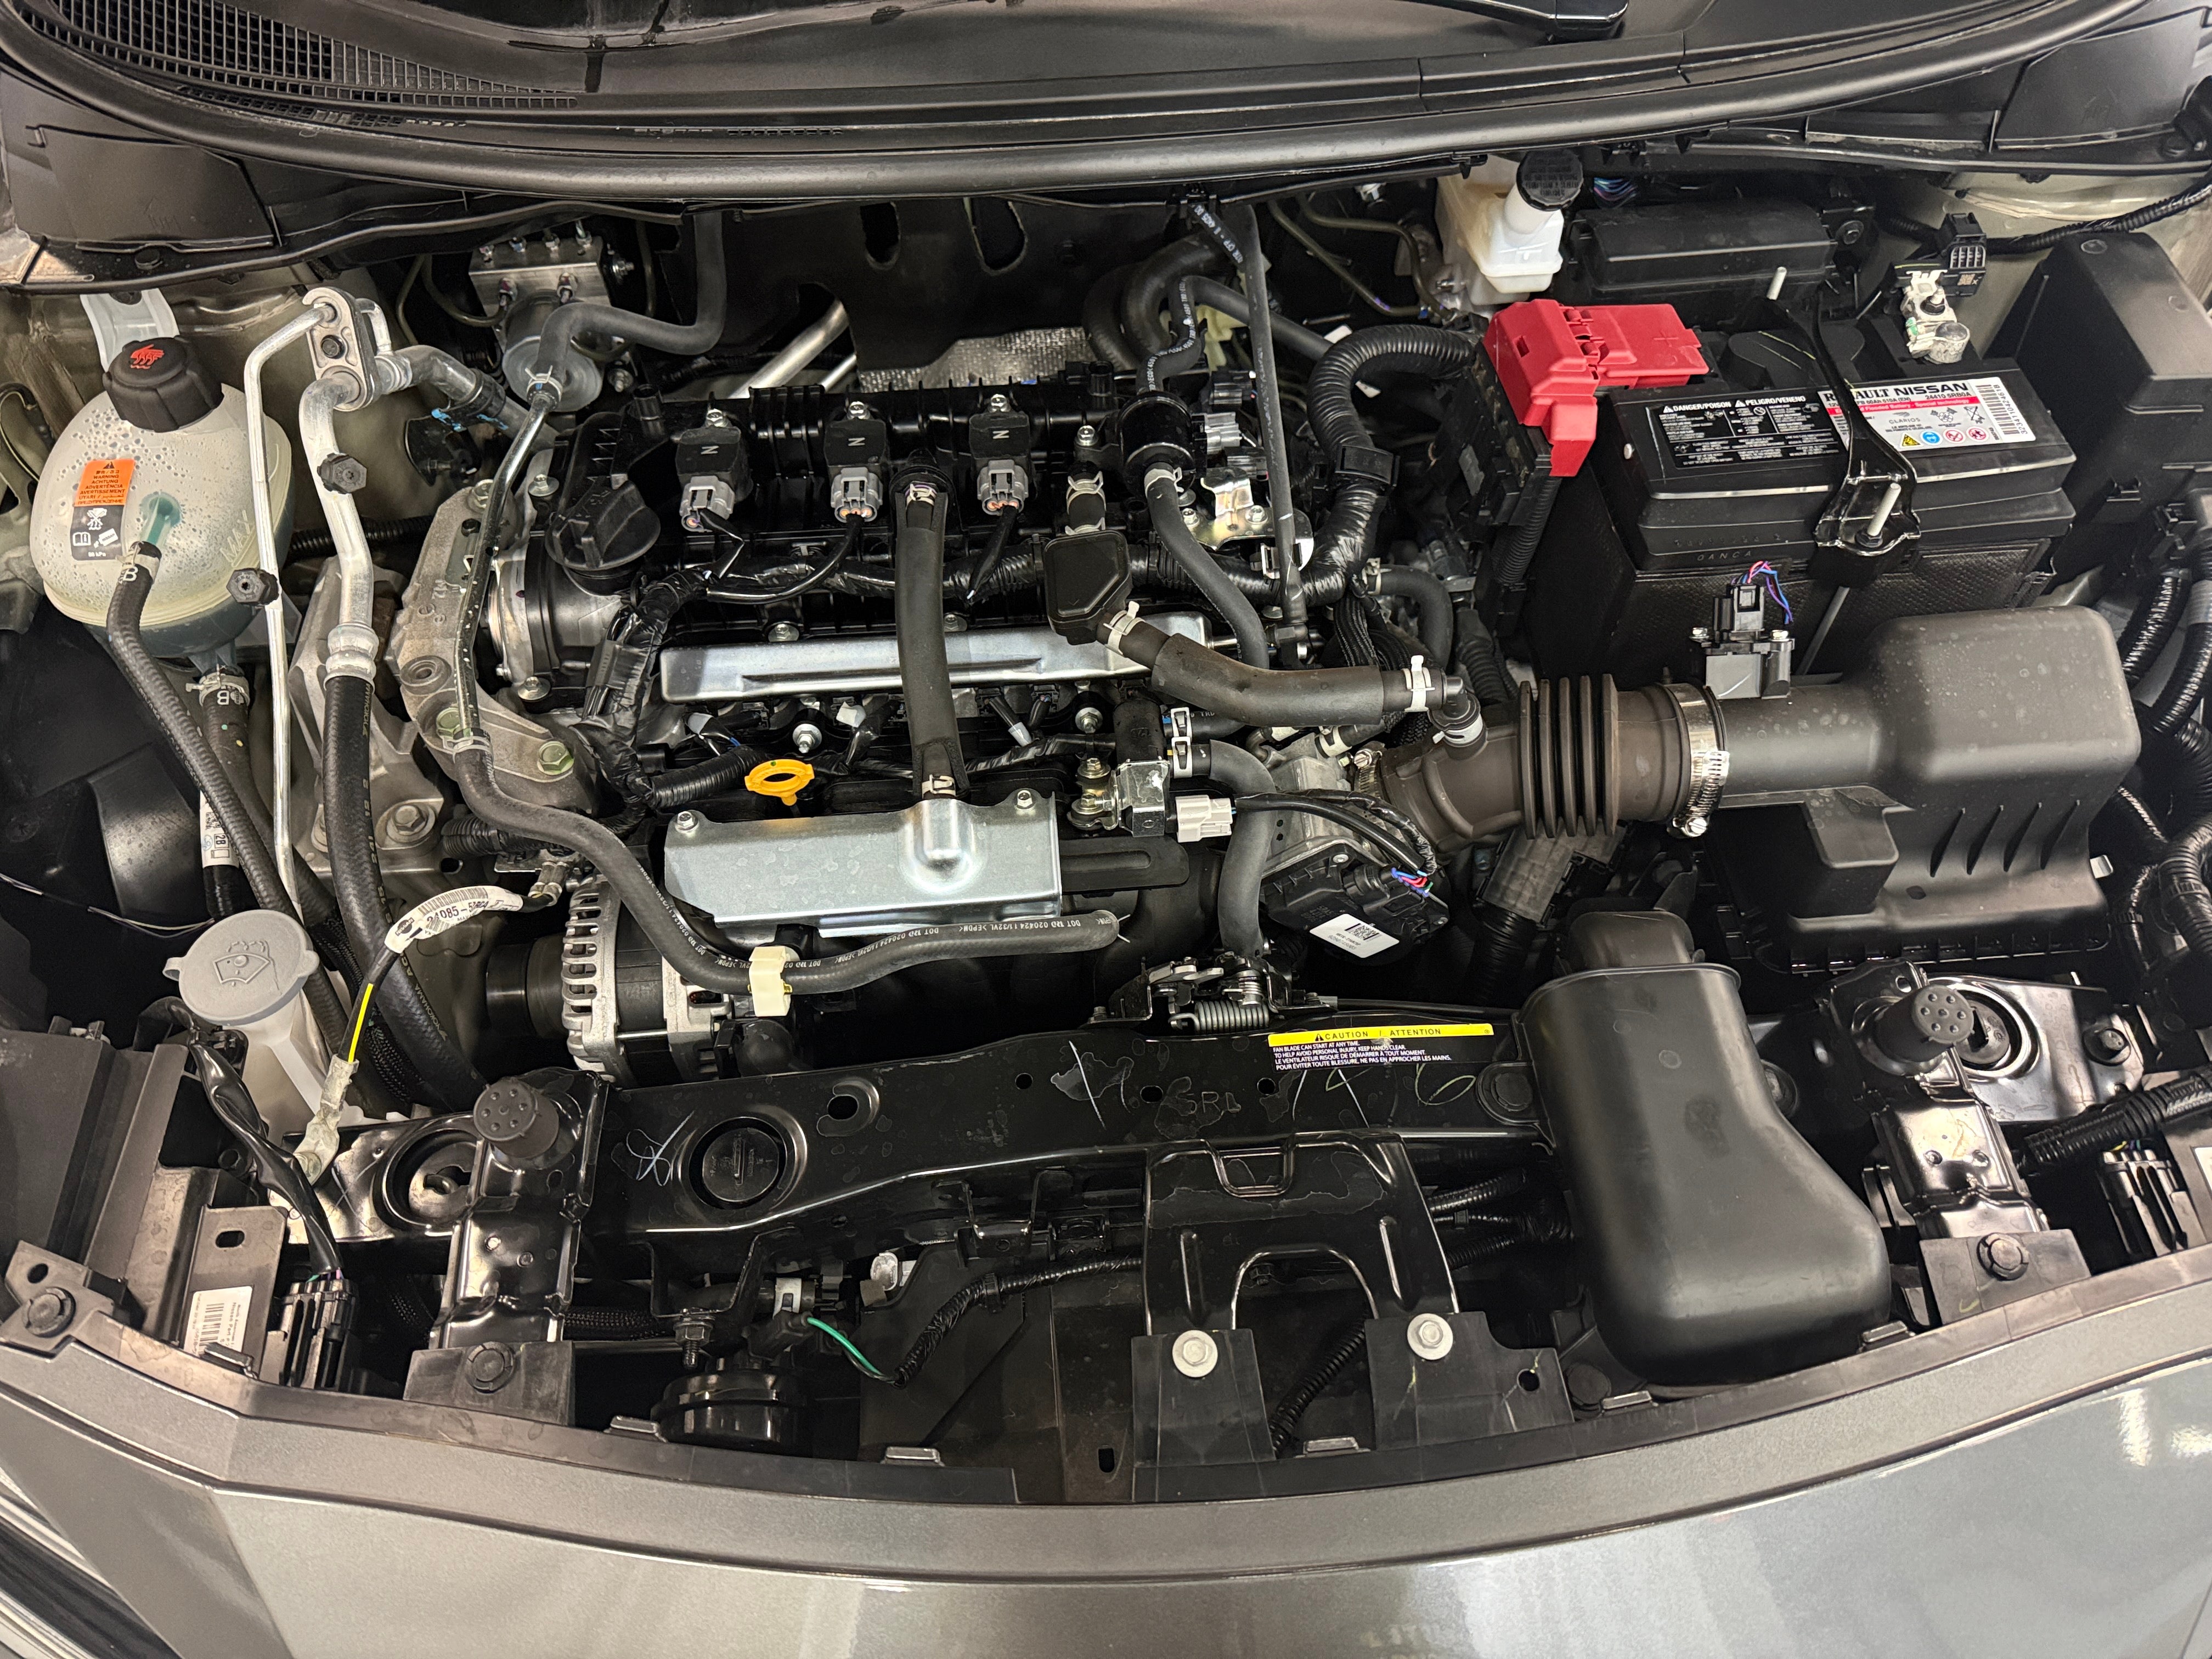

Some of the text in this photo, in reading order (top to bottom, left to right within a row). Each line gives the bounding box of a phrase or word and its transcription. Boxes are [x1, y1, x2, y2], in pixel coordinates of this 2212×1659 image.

[1823, 382, 1968, 402] RAULT NISSAN
[1673, 401, 1731, 411] DANGER/POISON
[1745, 396, 1806, 406] PELIGRO/VENENO
[363, 682, 372, 730] YOKOHAMA
[395, 917, 415, 936] NISSAN
[672, 913, 689, 936] 020424
[1019, 921, 1048, 929] 020424
[1067, 919, 1081, 928] DOT
[924, 927, 939, 935] DOT
[880, 933, 906, 947] 020424
[695, 945, 706, 956] DOT
[414, 983, 441, 1028] YOKOHAMA
[1325, 1031, 1368, 1040] CAUTION
[1390, 1028, 1441, 1036] ATTENTION
[1282, 1055, 1319, 1064] VENTILATEUR
[1349, 1050, 1379, 1058] DÉMARRER
[1293, 1061, 1312, 1069] ÉVITER
